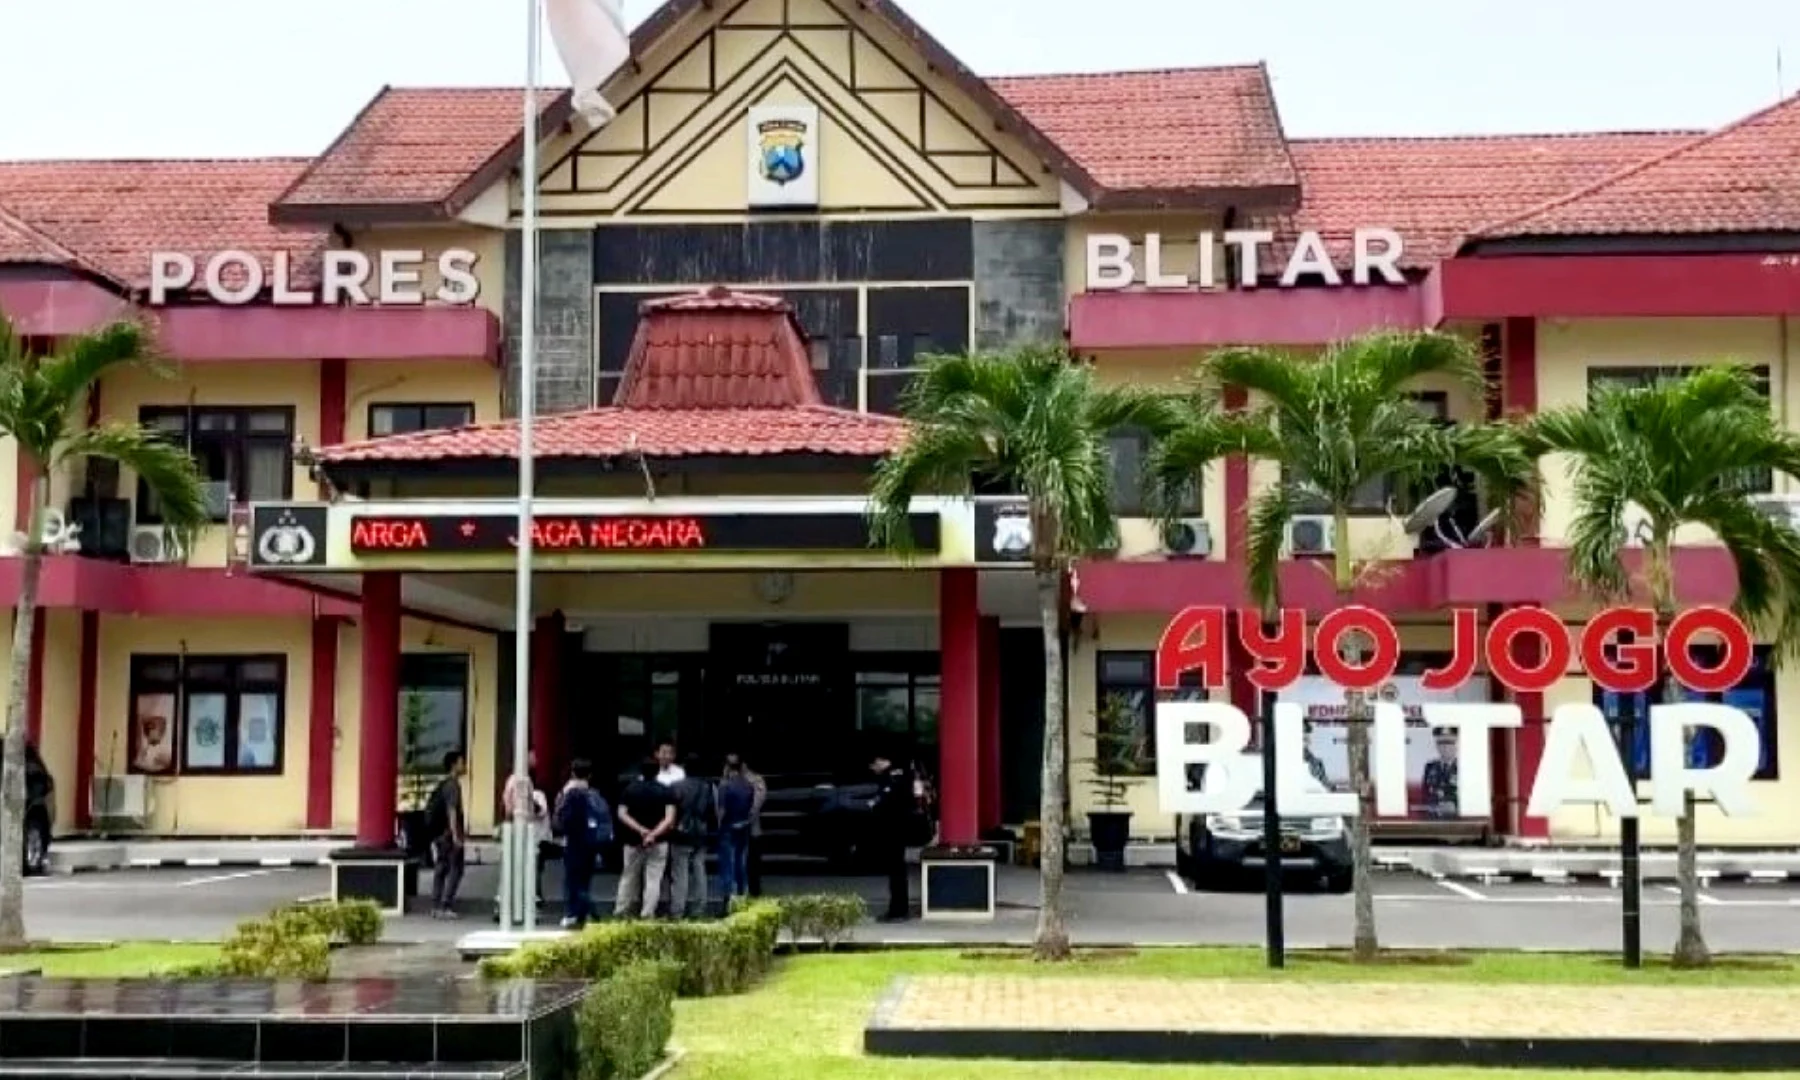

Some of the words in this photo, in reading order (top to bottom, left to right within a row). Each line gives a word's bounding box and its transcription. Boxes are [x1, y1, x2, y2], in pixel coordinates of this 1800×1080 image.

[150, 249, 481, 305] POLRES
[1086, 227, 1406, 289] BLITAR
[590, 519, 704, 547] NEGARA
[1155, 605, 1400, 692] AYO
[1420, 605, 1754, 693] JOGO
[1155, 702, 1760, 818] BLITAR
